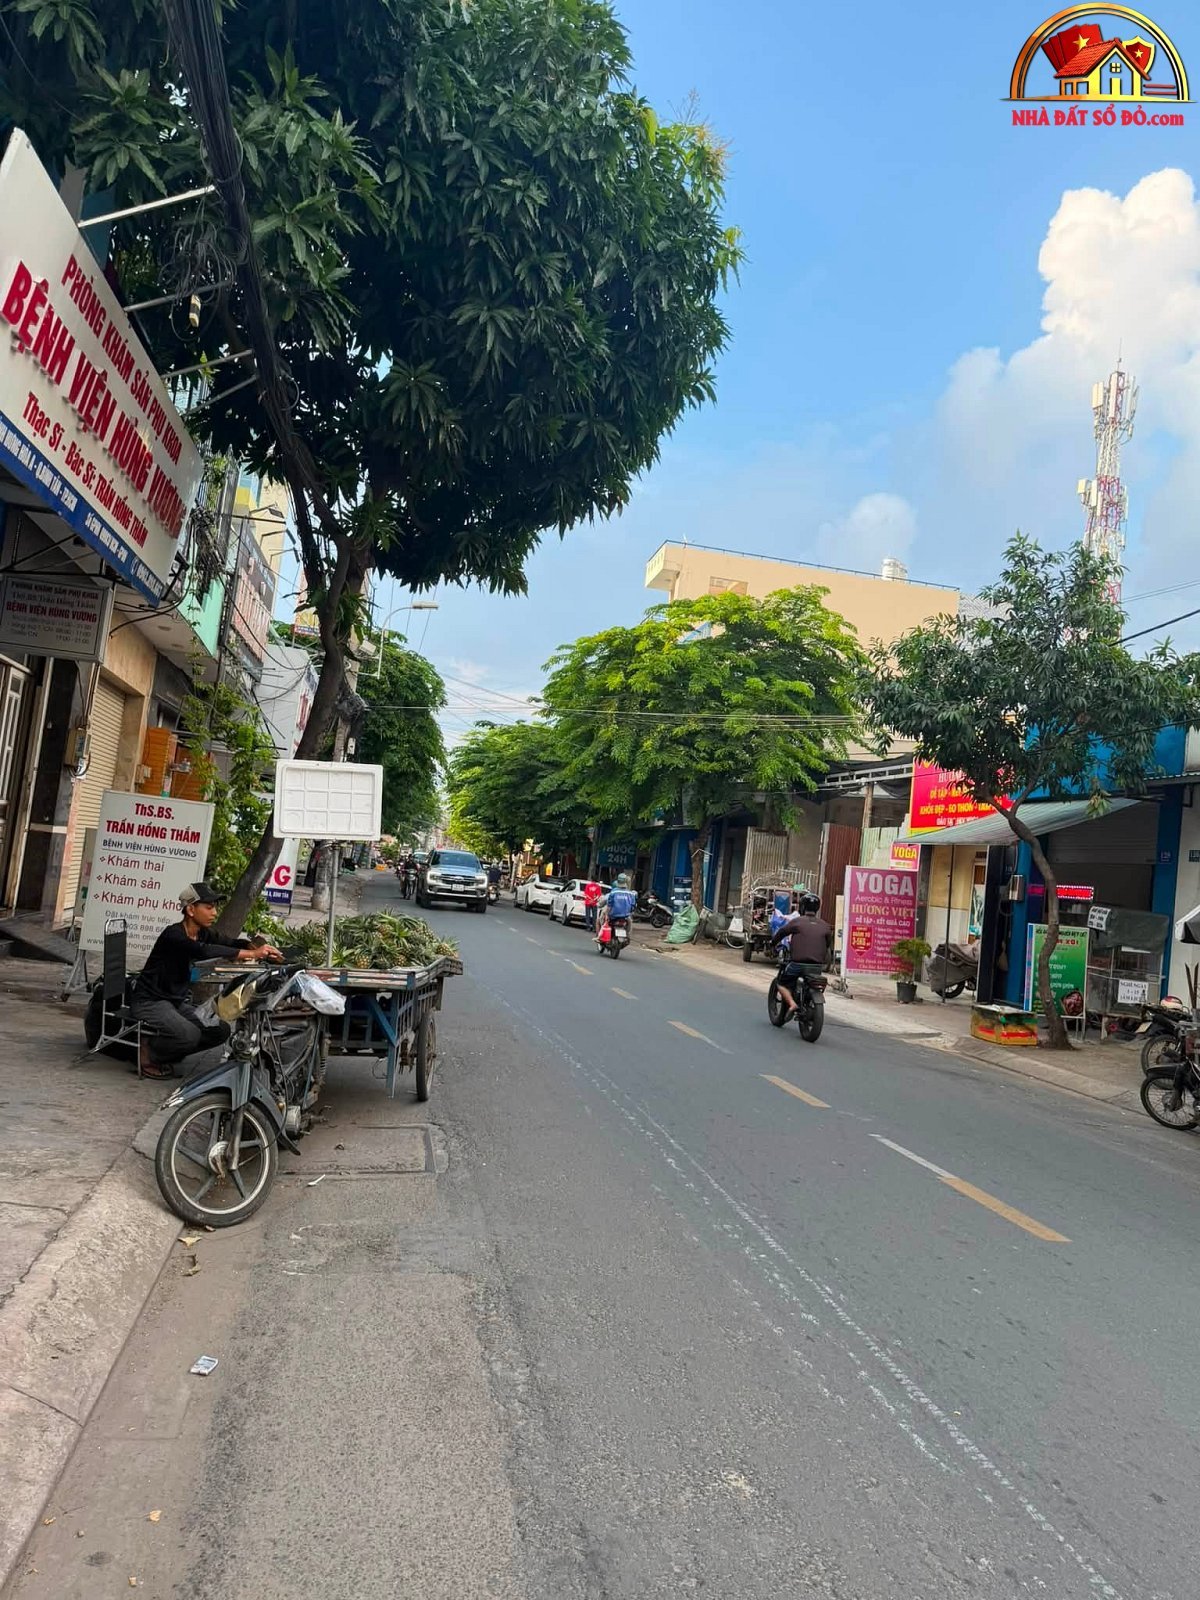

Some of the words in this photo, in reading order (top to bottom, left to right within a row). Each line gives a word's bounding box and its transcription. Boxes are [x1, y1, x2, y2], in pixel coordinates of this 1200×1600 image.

[61, 253, 107, 339] PHÒNG
[102, 320, 135, 385] KHÁM
[130, 369, 153, 413] SẢN
[147, 396, 167, 441] PHỤ
[161, 421, 182, 466] KHOA
[2, 260, 76, 387] BỆNH
[69, 350, 118, 442] VIỆN
[107, 410, 153, 493] HÙNG
[23, 390, 51, 438] Thạc
[49, 422, 65, 452] Sĩ
[65, 440, 85, 476] Bác
[135, 803, 175, 820] ThS.BS.
[102, 838, 123, 849] BỆNH
[125, 841, 142, 852] VIỆN
[894, 846, 917, 859] YOGA
[107, 854, 140, 869] Khám
[144, 859, 165, 872] thai
[104, 873, 137, 887] Khám
[140, 877, 161, 890] sản
[856, 872, 914, 896] YOGA
[101, 890, 134, 905] Khám
[137, 896, 159, 910] phụ
[162, 898, 182, 912] kho
[852, 903, 889, 915] HƯƠNG
